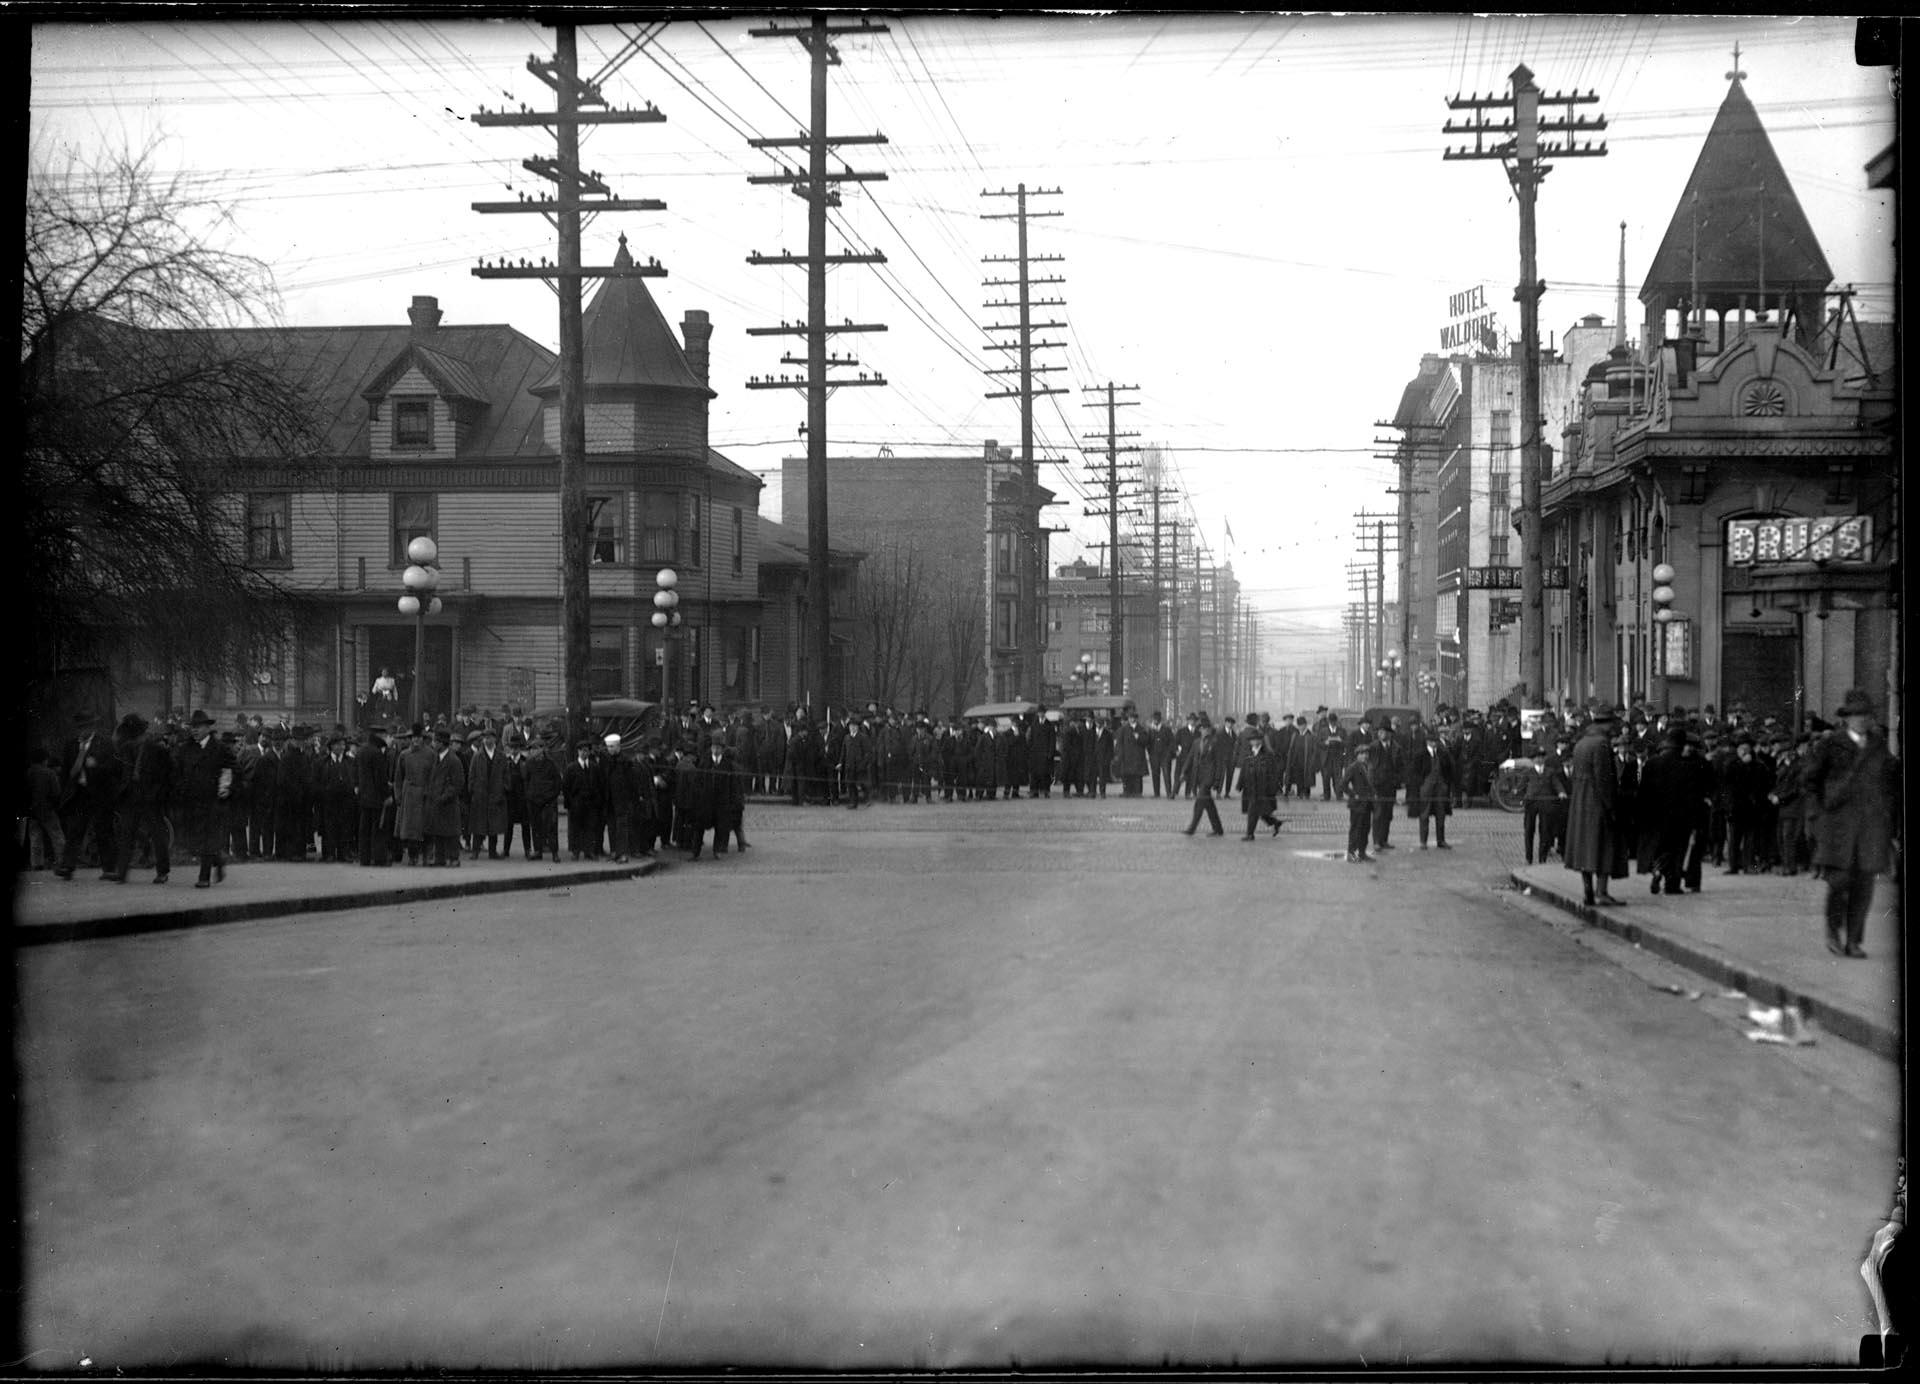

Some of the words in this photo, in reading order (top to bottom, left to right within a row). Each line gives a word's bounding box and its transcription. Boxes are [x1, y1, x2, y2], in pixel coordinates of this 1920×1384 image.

[1449, 284, 1488, 318] HOTEL
[1440, 311, 1498, 350] WALDORF
[1734, 522, 1861, 561] DRUGS
